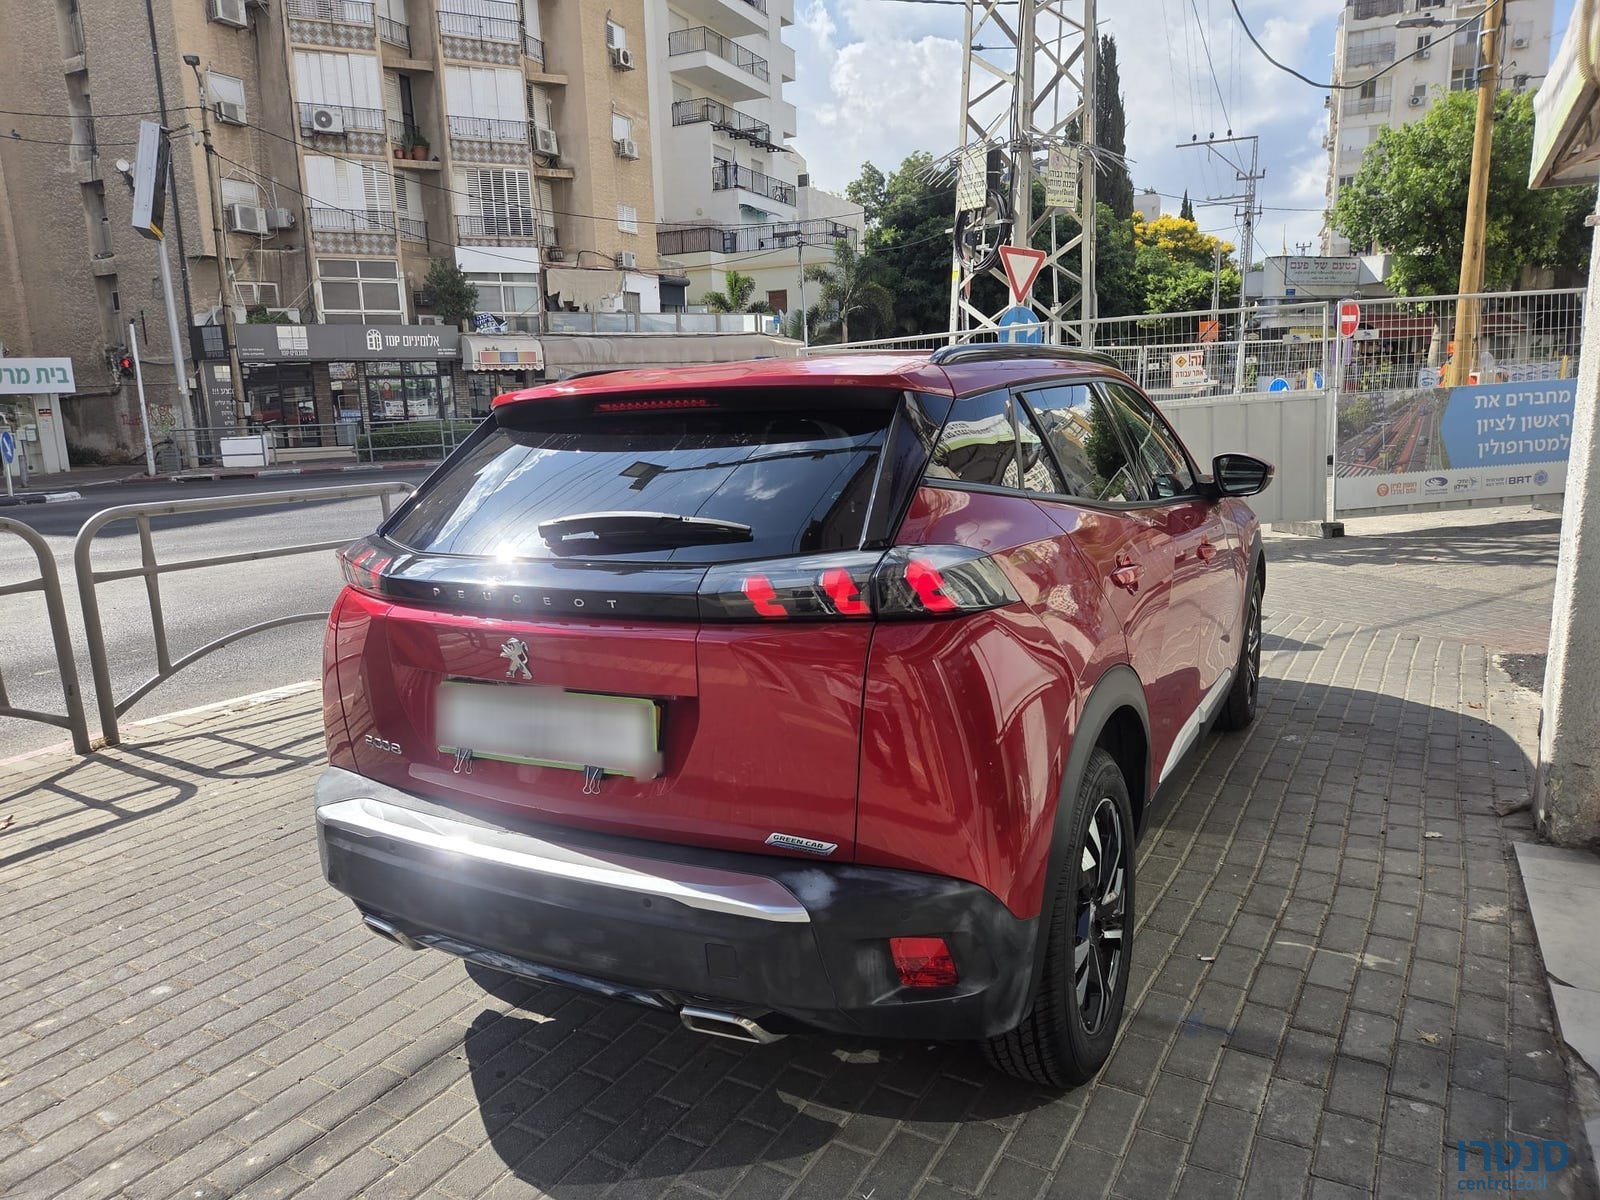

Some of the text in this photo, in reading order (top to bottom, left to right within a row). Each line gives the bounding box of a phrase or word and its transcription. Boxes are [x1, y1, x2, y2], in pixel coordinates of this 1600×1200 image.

[1314, 259, 1328, 270] של
[402, 333, 440, 347] אלומיניום
[36, 367, 70, 385] בית
[1175, 370, 1192, 378] עבודה
[1474, 390, 1571, 409] מחברים את
[1476, 413, 1570, 436] ראשון לציון
[1478, 433, 1570, 459] למטרופולין
[1508, 475, 1532, 486] BRT
[433, 587, 617, 609] PEUGEOT
[365, 734, 402, 755] 2008
[773, 834, 824, 849] GREEN CAR
